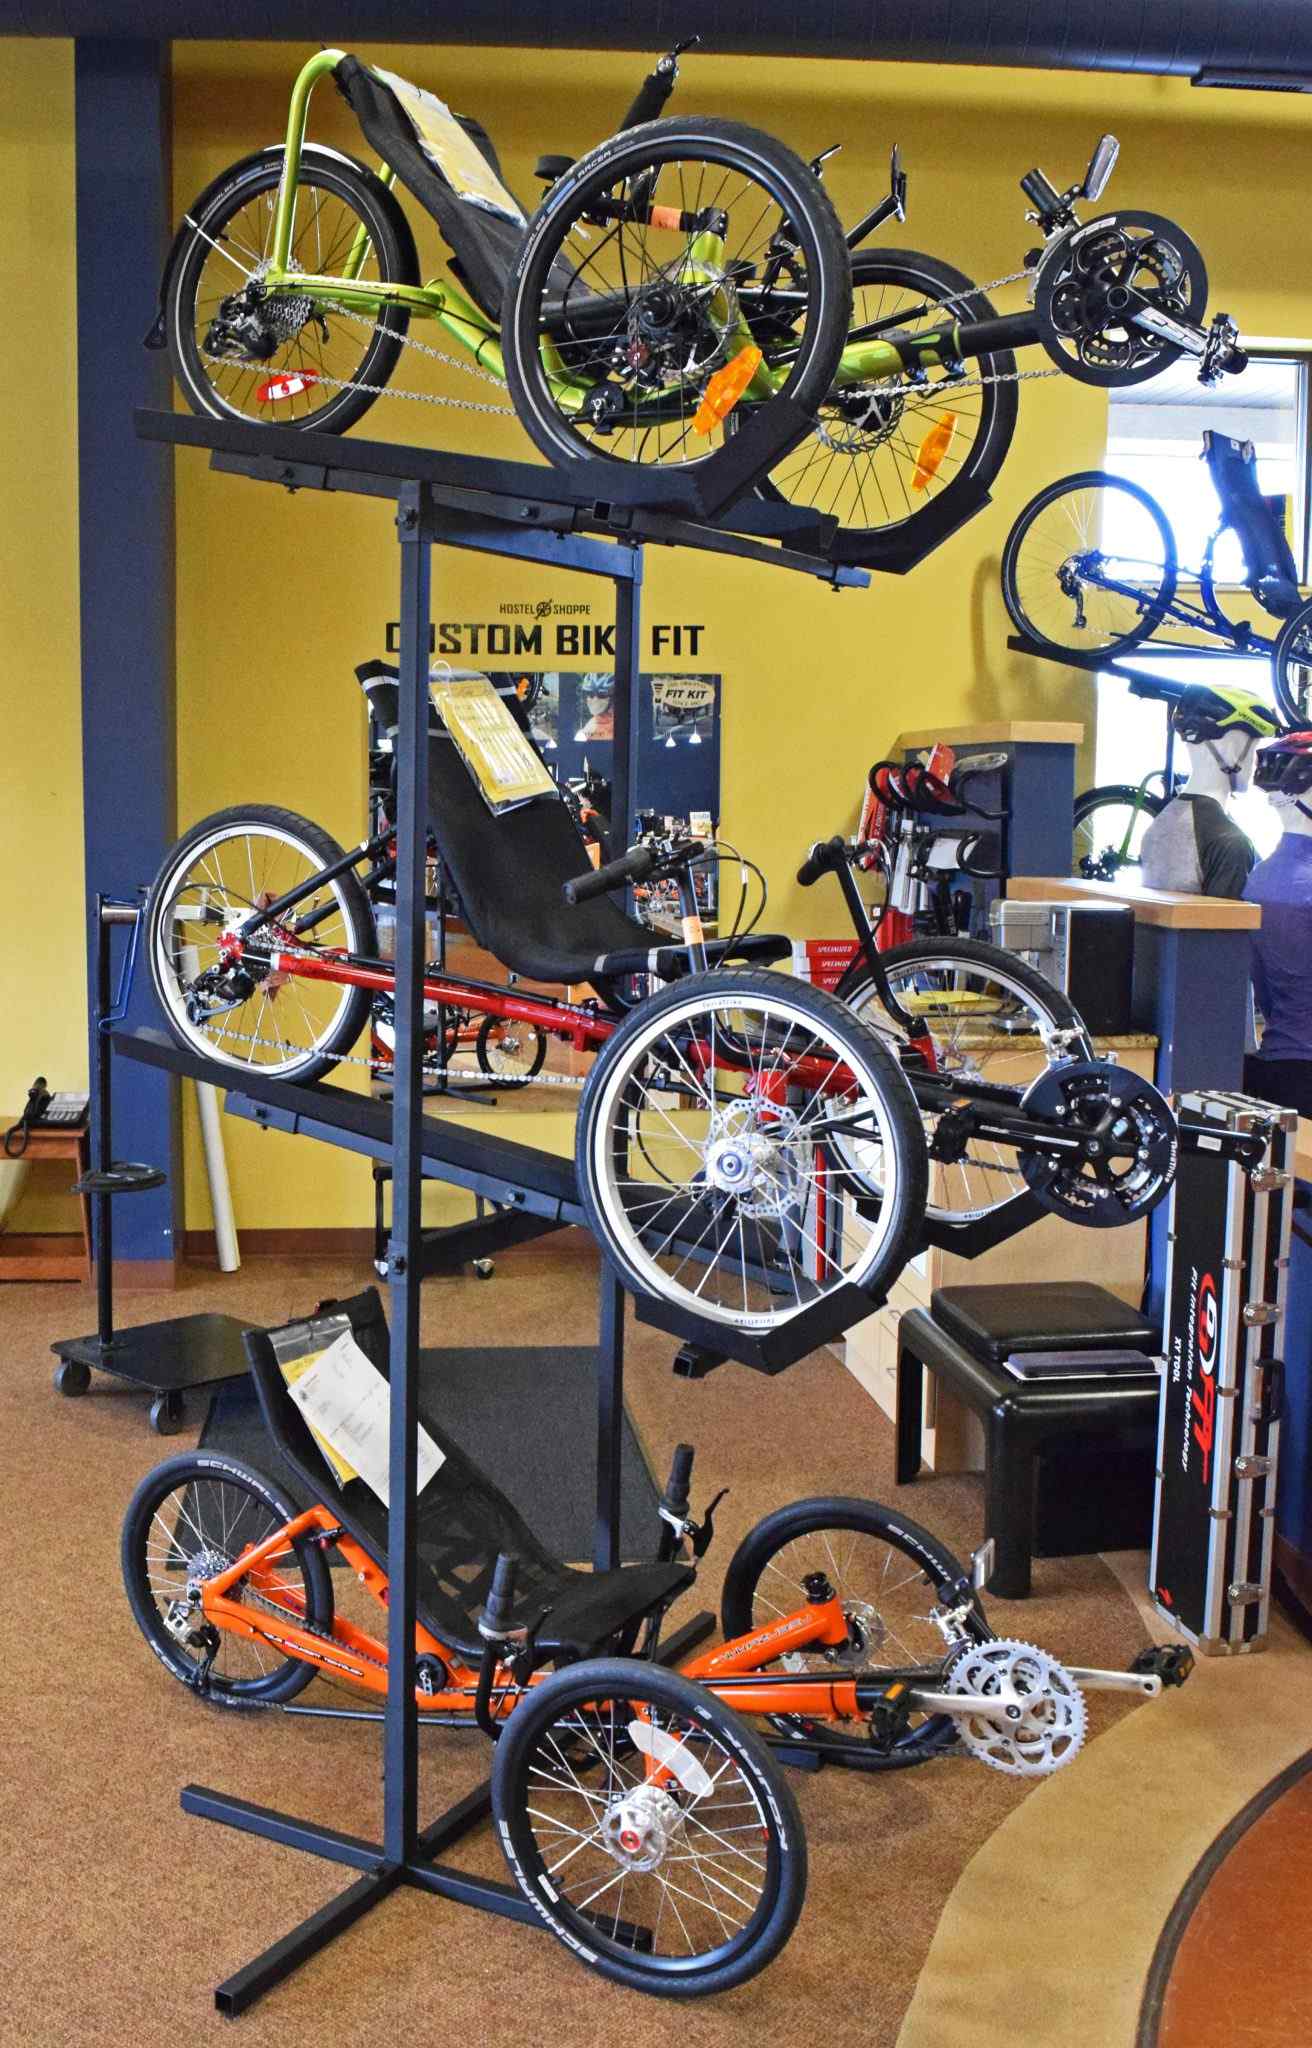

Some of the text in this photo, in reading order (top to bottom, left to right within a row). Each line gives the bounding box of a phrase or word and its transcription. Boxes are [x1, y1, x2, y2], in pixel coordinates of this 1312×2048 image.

[499, 604, 591, 616] HOSTEL SHOPPE
[386, 622, 705, 656] CSTOM BIK FIT
[665, 689, 708, 700] FIT KIT
[1172, 1335, 1182, 1383] XY TOOL
[1187, 1293, 1197, 1380] Integration
[1182, 1384, 1193, 1473] Technology
[498, 1819, 599, 1964] SCHWALBE
